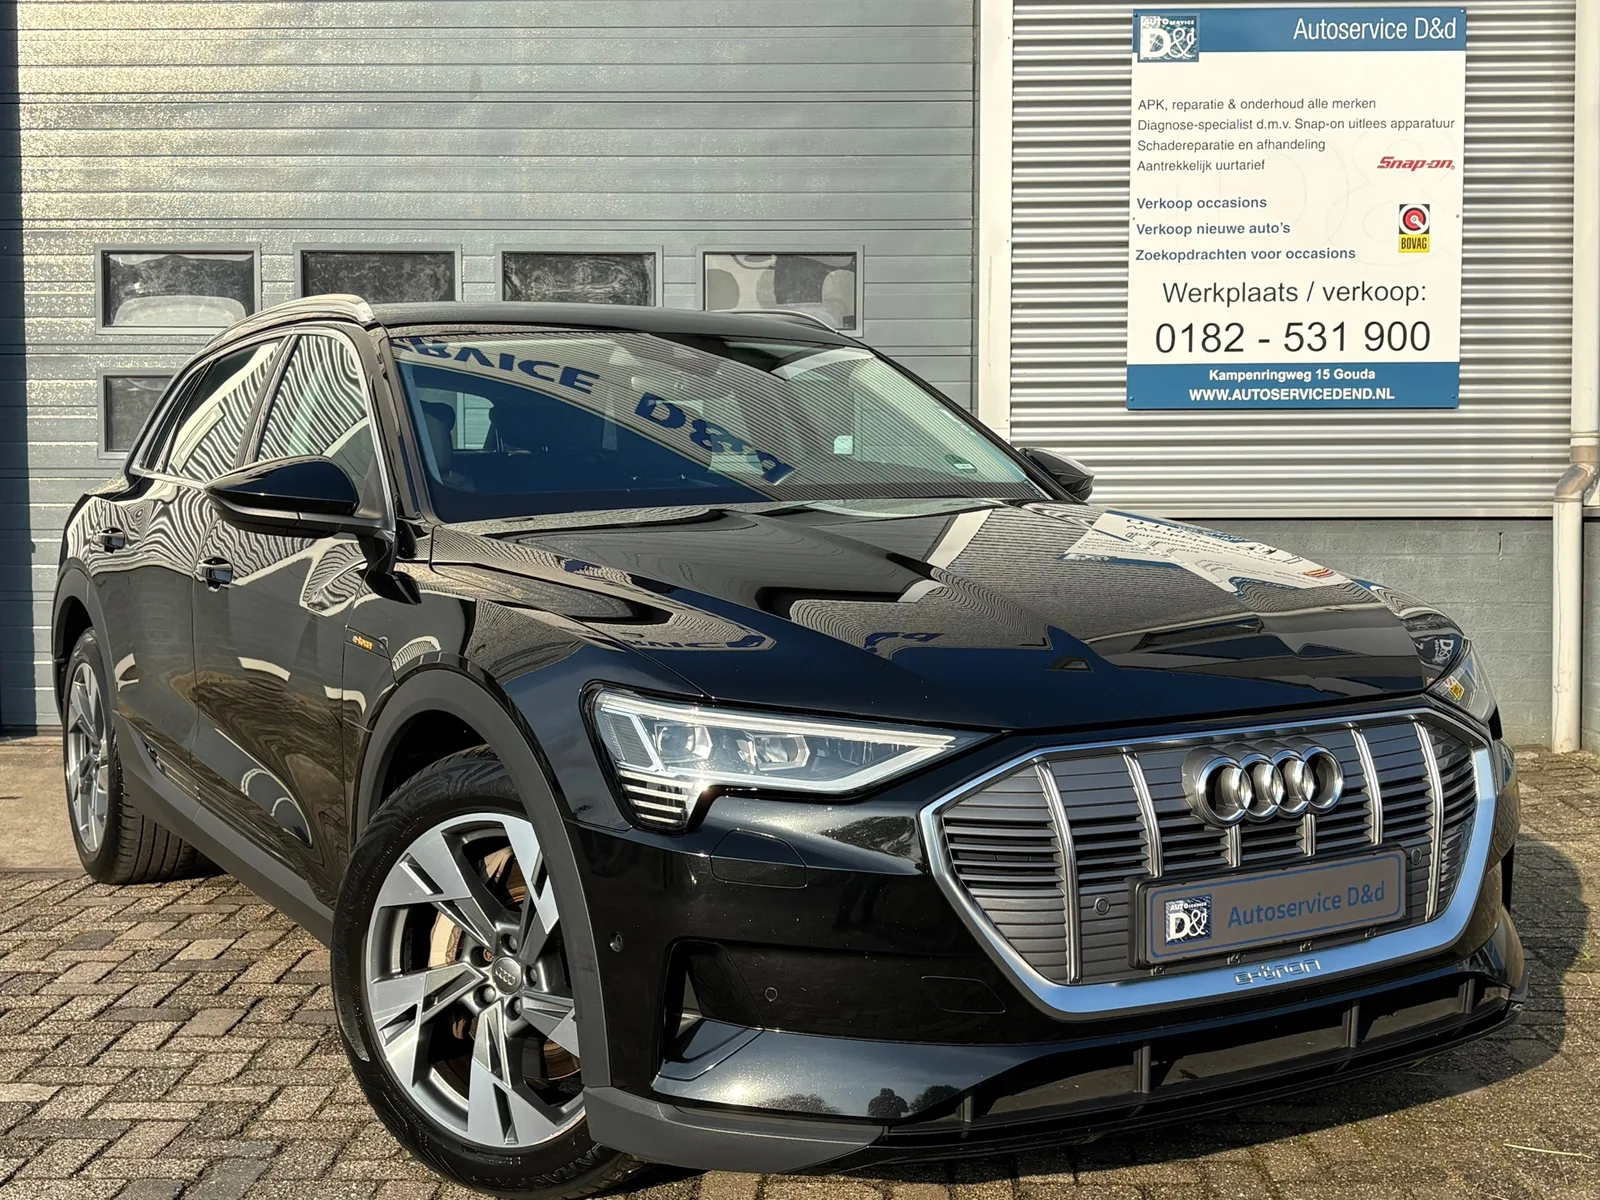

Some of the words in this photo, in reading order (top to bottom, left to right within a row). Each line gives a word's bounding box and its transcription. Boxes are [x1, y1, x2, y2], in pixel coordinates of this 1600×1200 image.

[1293, 18, 1407, 40] Autoservice
[1415, 17, 1456, 39] D&d
[1138, 99, 1167, 111] APK,
[1173, 99, 1224, 112] reparatie
[1228, 99, 1236, 109] &
[1241, 98, 1304, 109] onderhoud
[1308, 98, 1328, 109] alle
[1332, 98, 1375, 108] merken
[1138, 119, 1252, 133] Diagnose-specialist
[1257, 119, 1291, 129] d.m.v.
[1295, 118, 1344, 131] Snap-on
[1349, 118, 1386, 129] uitlees
[1391, 119, 1455, 131] apparatuur
[1138, 140, 1234, 153] Schadereparatie
[1238, 142, 1252, 150] en
[1257, 139, 1325, 152] afhandeling
[1137, 160, 1212, 173] Aantrekkelijk
[1216, 159, 1265, 170] uurtarief
[1137, 198, 1192, 211] Verkoop
[1197, 197, 1267, 208] occasions
[1137, 224, 1192, 237] Verkoop
[1197, 223, 1245, 234] nieuwe
[1401, 237, 1427, 249] BOVAG
[1136, 249, 1246, 263] Zoekopdrachten
[1251, 251, 1281, 259] voor
[1286, 248, 1355, 259] occasions
[1163, 282, 1298, 307] Werkplaats
[1307, 281, 1314, 302] /
[1323, 281, 1425, 306] verkoop:
[1156, 323, 1244, 353] 0182
[1284, 322, 1344, 352] 531
[1365, 321, 1430, 351] 900
[1210, 369, 1311, 383] Kampenringweg
[1316, 369, 1330, 379] 15
[1334, 369, 1375, 379] Gouda
[1189, 388, 1395, 401] WWW.AUTOSERVICEDEND.NL
[1228, 892, 1342, 927] Autoservice
[1347, 881, 1385, 907] D&d
[1234, 959, 1321, 985] e-tron
